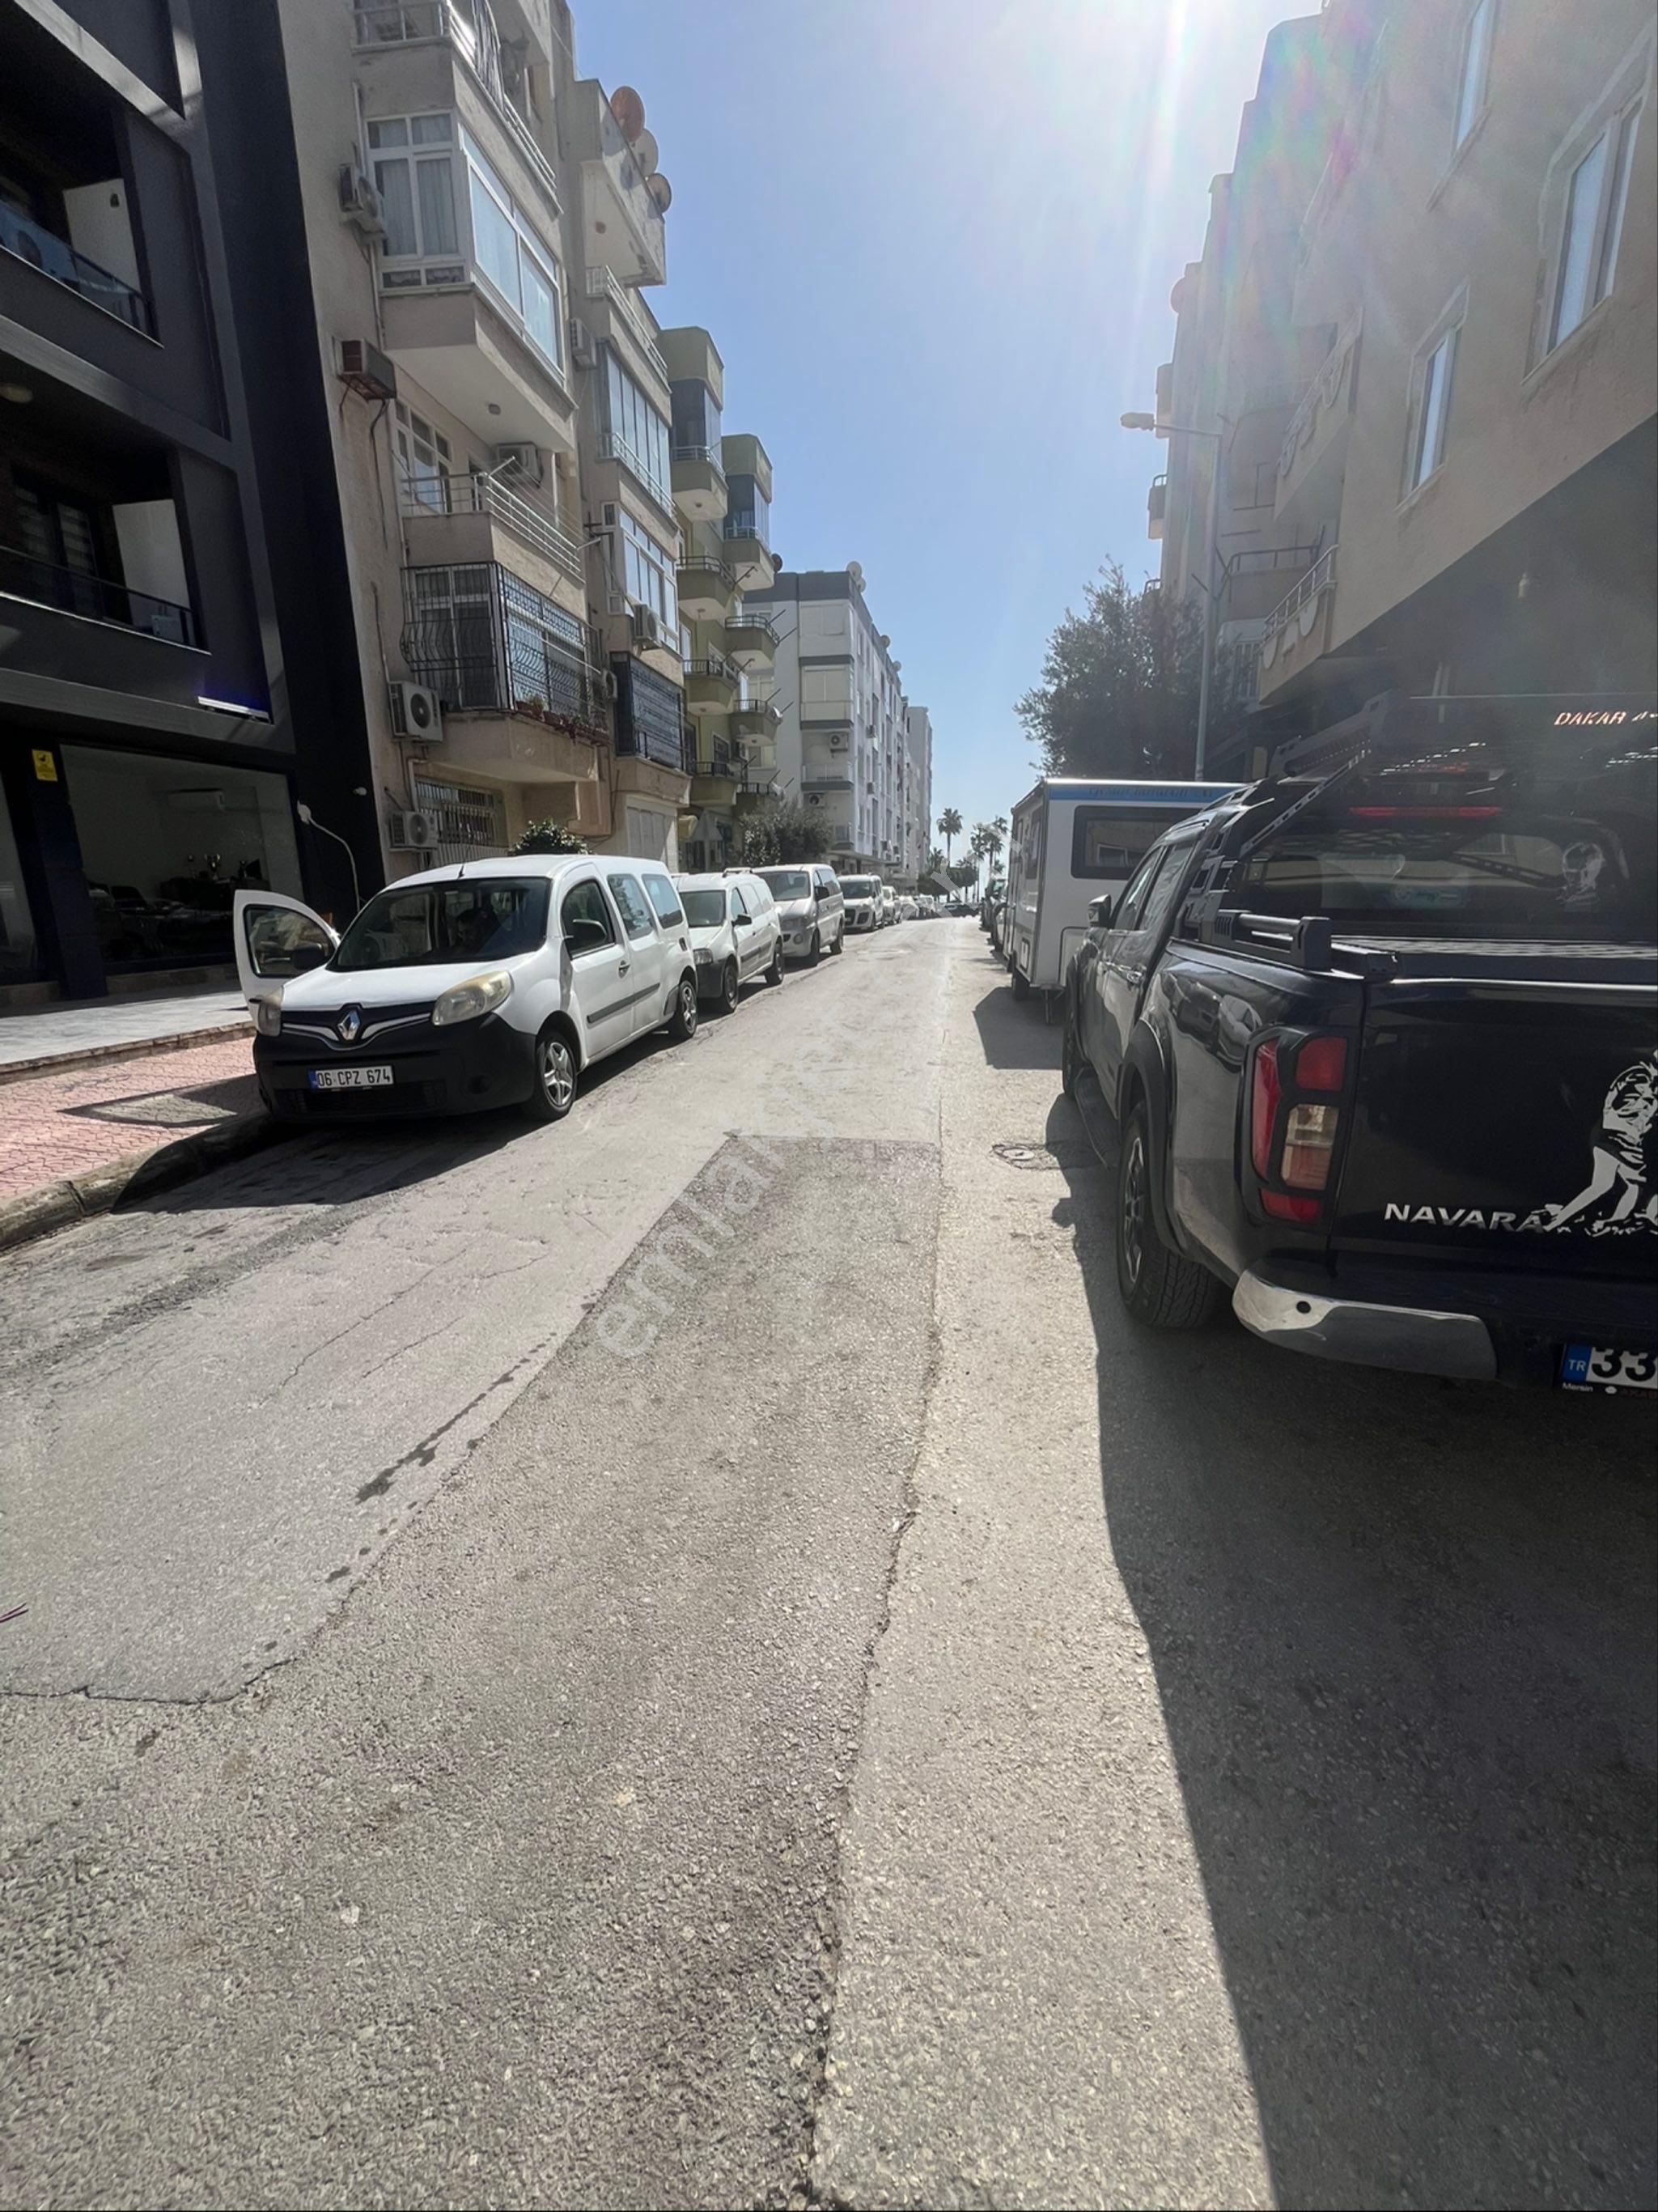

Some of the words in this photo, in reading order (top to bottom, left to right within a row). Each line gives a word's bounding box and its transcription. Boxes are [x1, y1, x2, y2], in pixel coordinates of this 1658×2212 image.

[1554, 711, 1627, 726] DAKAR
[317, 1072, 333, 1086] 06
[337, 1071, 361, 1085] CPZ
[367, 1069, 390, 1084] 674
[1384, 1203, 1544, 1233] NAVARA
[1568, 1359, 1586, 1372] TR
[1592, 1346, 1657, 1382] 33
